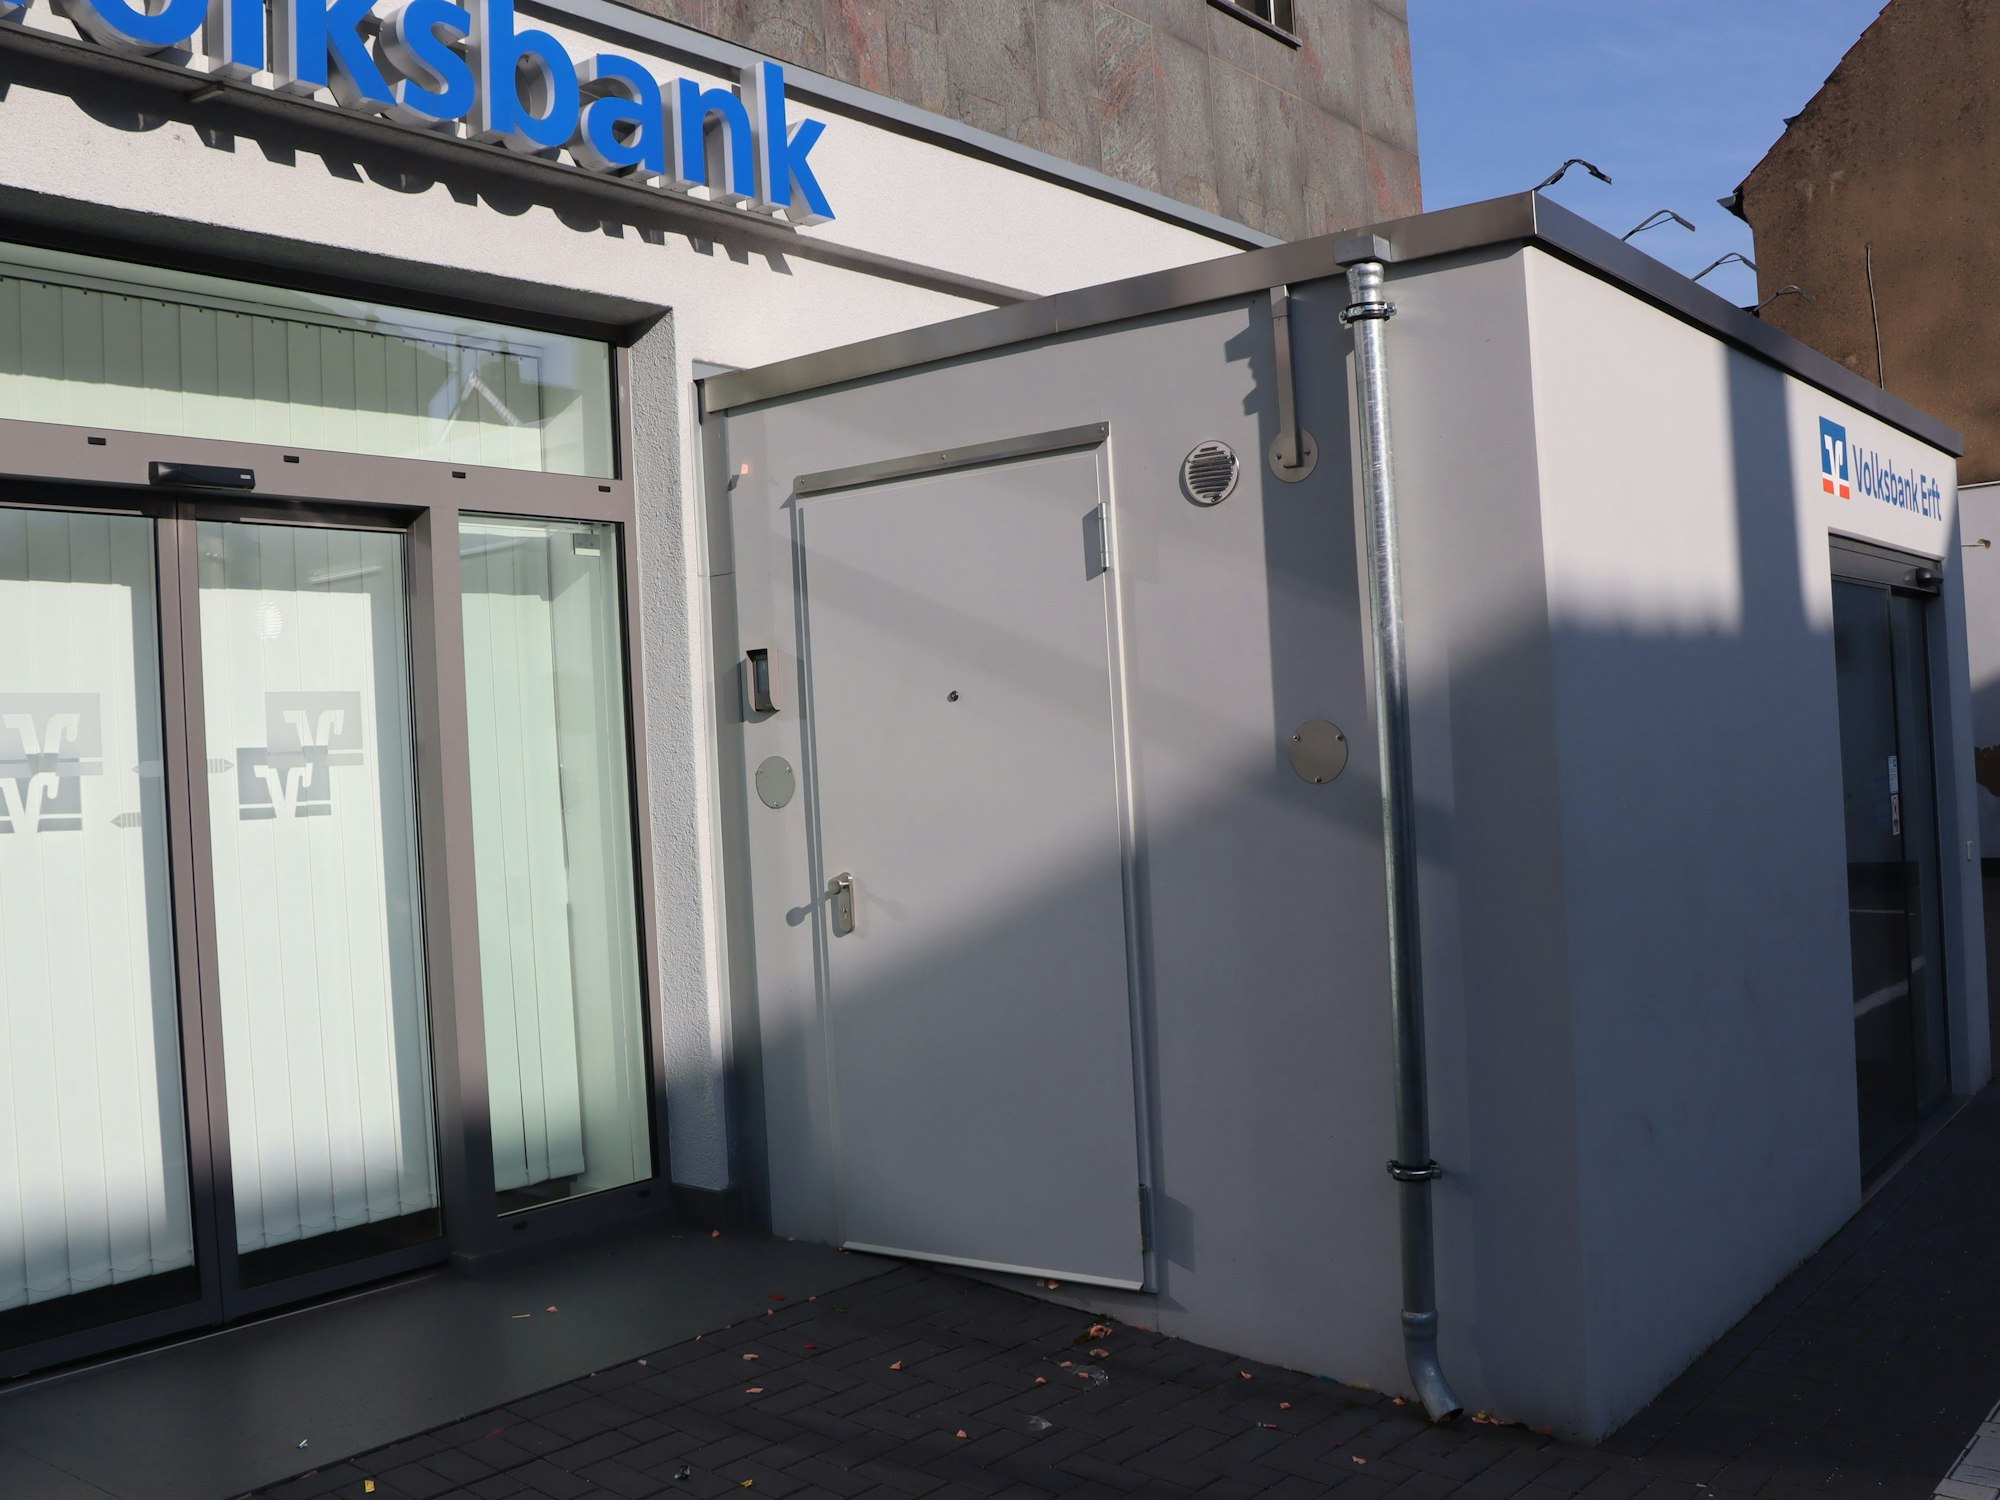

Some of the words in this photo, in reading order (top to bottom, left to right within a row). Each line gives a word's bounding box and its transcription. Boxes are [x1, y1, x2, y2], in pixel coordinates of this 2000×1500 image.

[0, 0, 836, 223] ksbank
[1852, 444, 1920, 514] Volksbank
[1919, 474, 1942, 522] Erft
